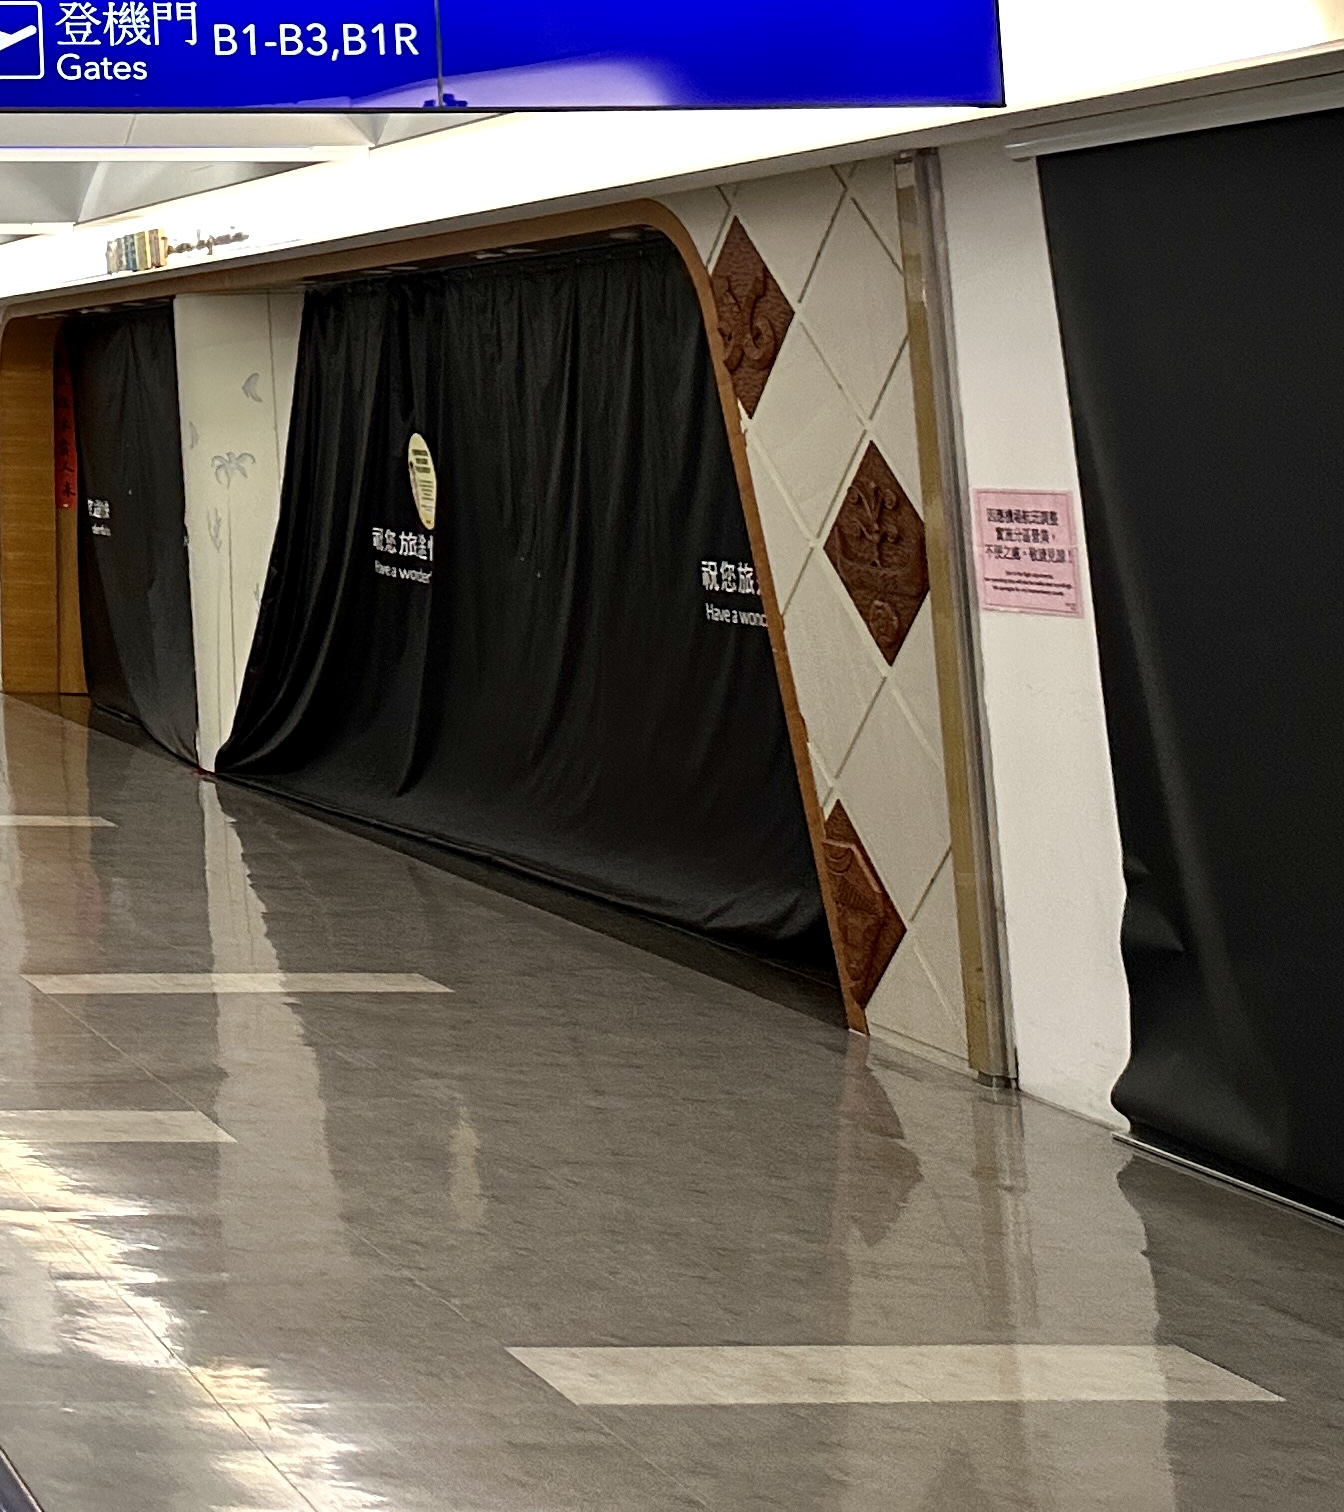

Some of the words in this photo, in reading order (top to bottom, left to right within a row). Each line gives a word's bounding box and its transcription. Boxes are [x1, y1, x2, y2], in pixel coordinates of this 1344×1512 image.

[55, 1, 198, 47] 登機門
[214, 23, 420, 61] B1-B3,B1R
[56, 52, 148, 81] Gates
[701, 560, 761, 596] 祝您旅
[705, 603, 731, 623] Have
